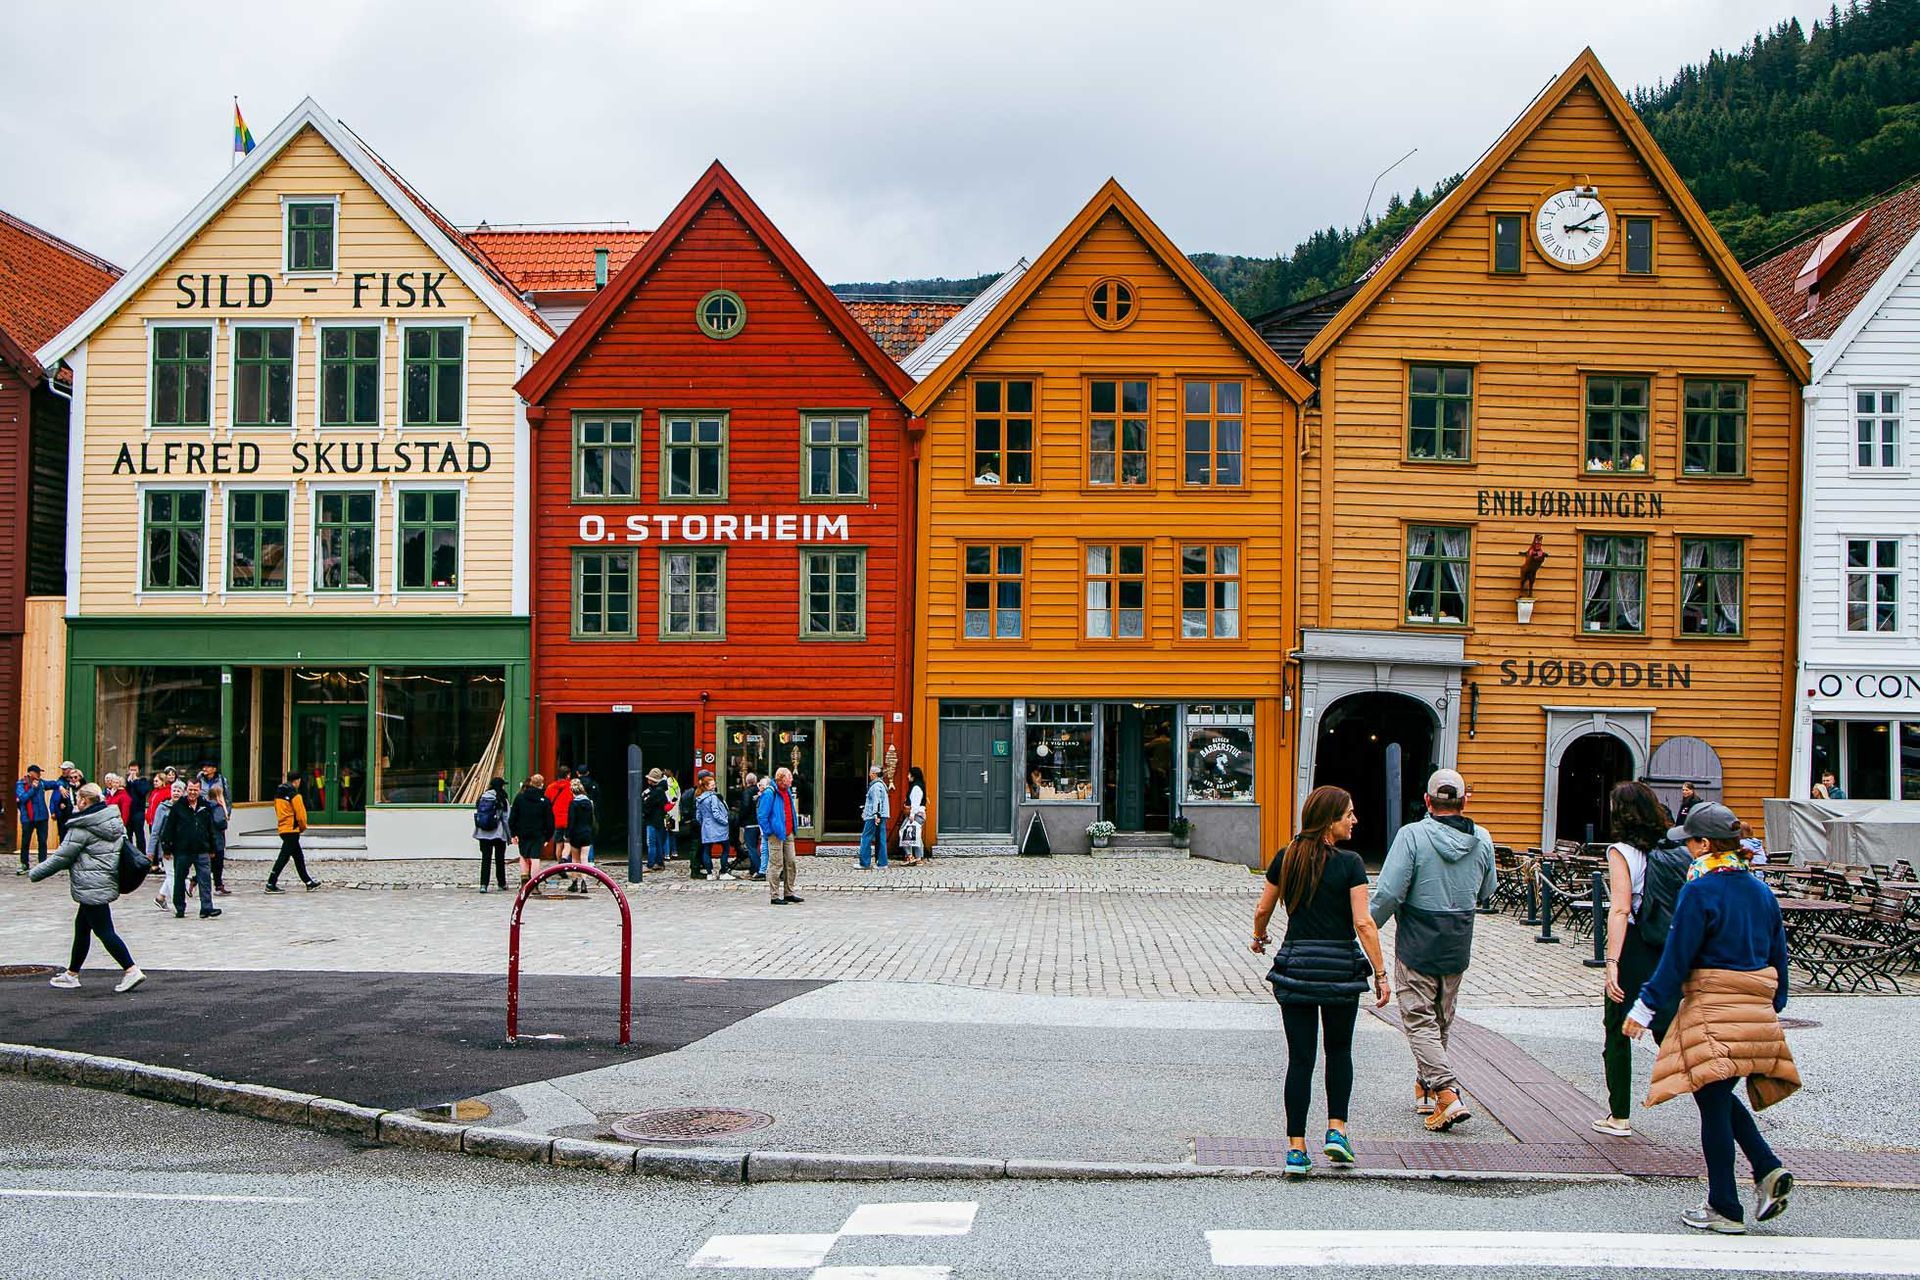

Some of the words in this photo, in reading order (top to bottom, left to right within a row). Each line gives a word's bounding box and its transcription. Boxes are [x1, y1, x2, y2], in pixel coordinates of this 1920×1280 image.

[176, 273, 274, 309] SILD
[352, 272, 447, 309] FISK
[112, 441, 261, 475] ALFRED
[291, 441, 492, 474] SKULSTAD
[1476, 490, 1665, 519] ENHJØRNINGEN
[579, 514, 616, 542] O.
[626, 514, 850, 542] STORHEIM
[1499, 659, 1692, 689] SJØBODEN
[1199, 742, 1242, 758] BARBERSTUE
